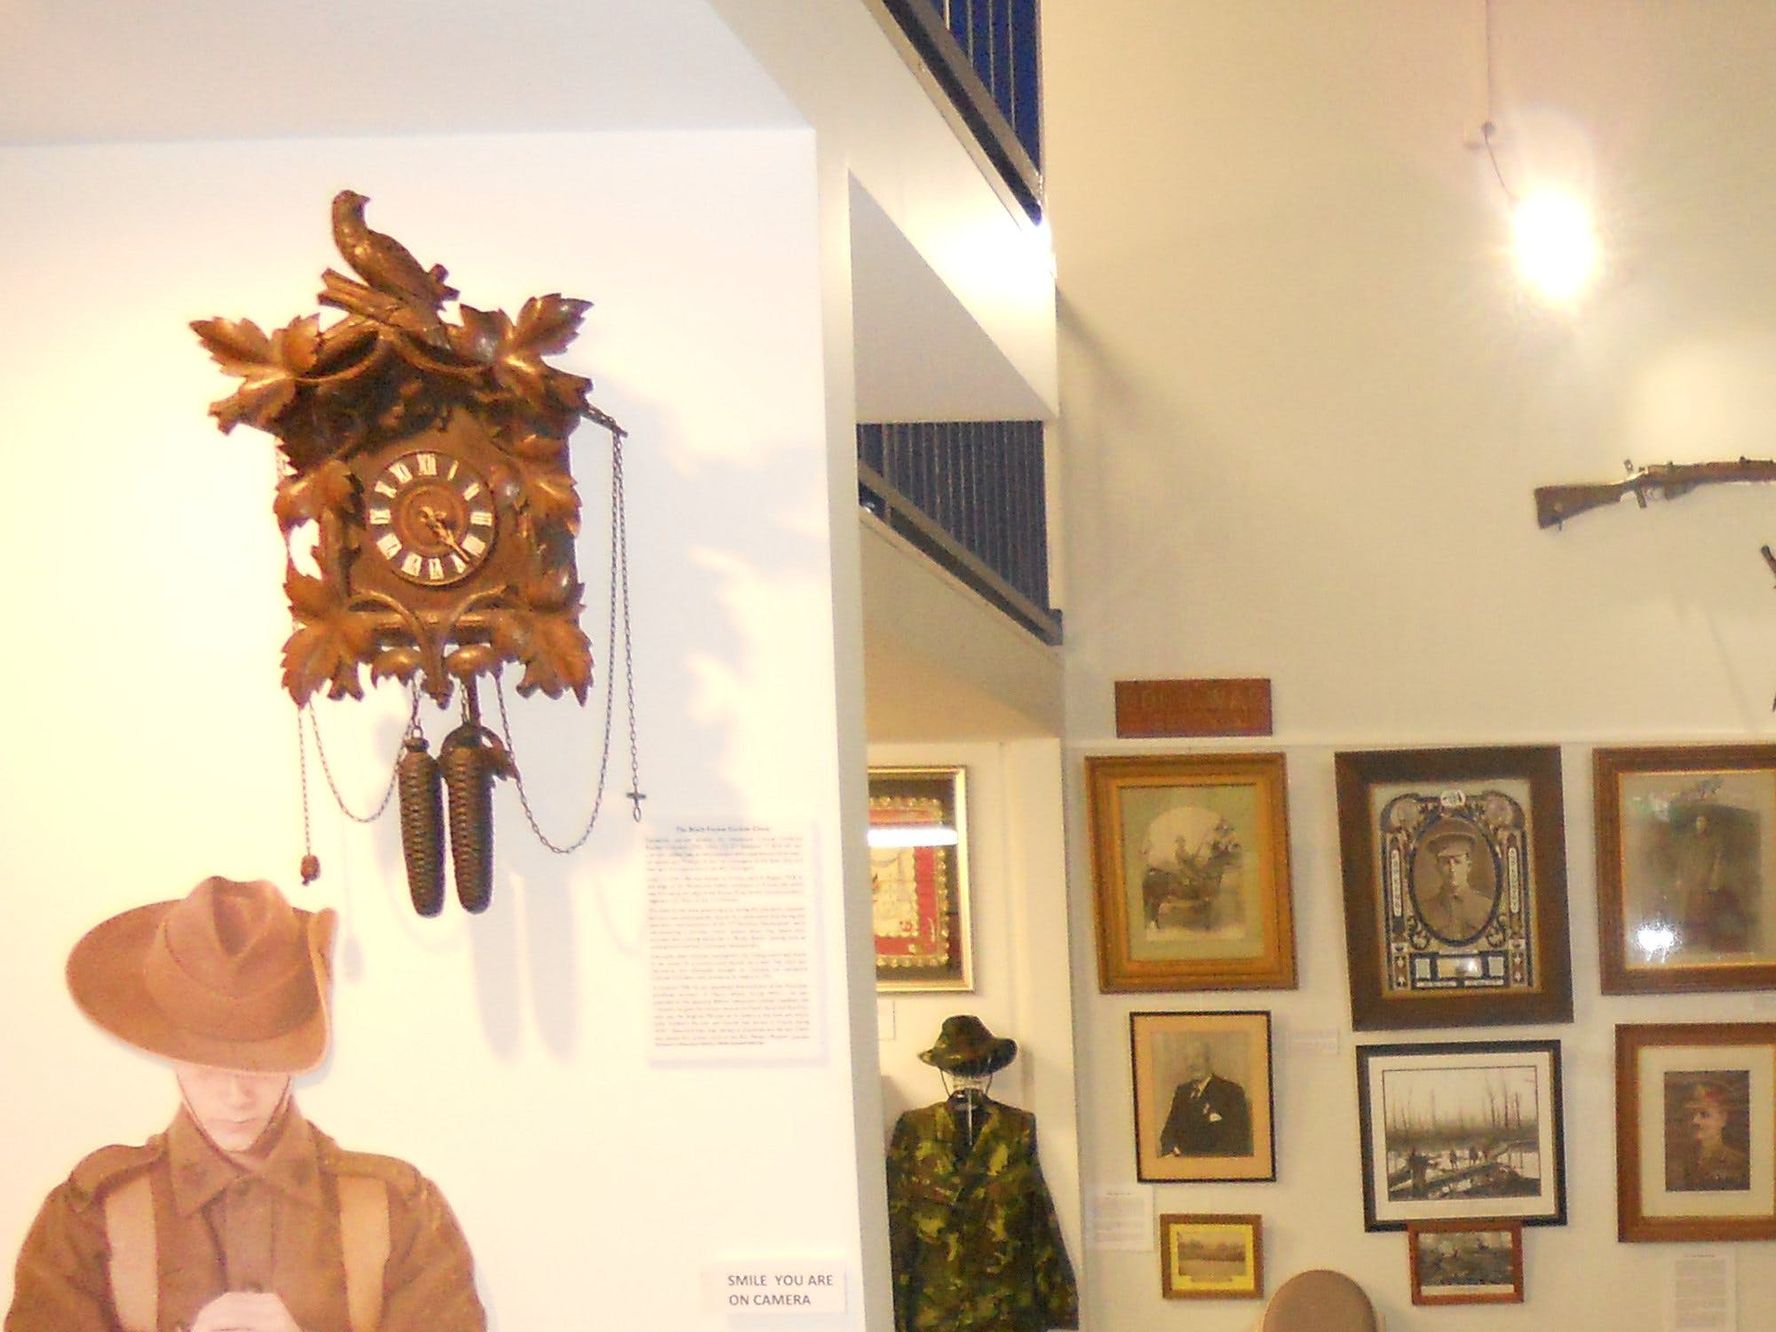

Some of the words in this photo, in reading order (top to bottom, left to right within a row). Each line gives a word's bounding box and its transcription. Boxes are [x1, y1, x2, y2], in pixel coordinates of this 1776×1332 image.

[728, 1275, 767, 1286] SMILE
[775, 1275, 804, 1286] YOU
[808, 1275, 833, 1286] ARE
[729, 1294, 750, 1306] ON
[753, 1294, 811, 1306] CAMERA
